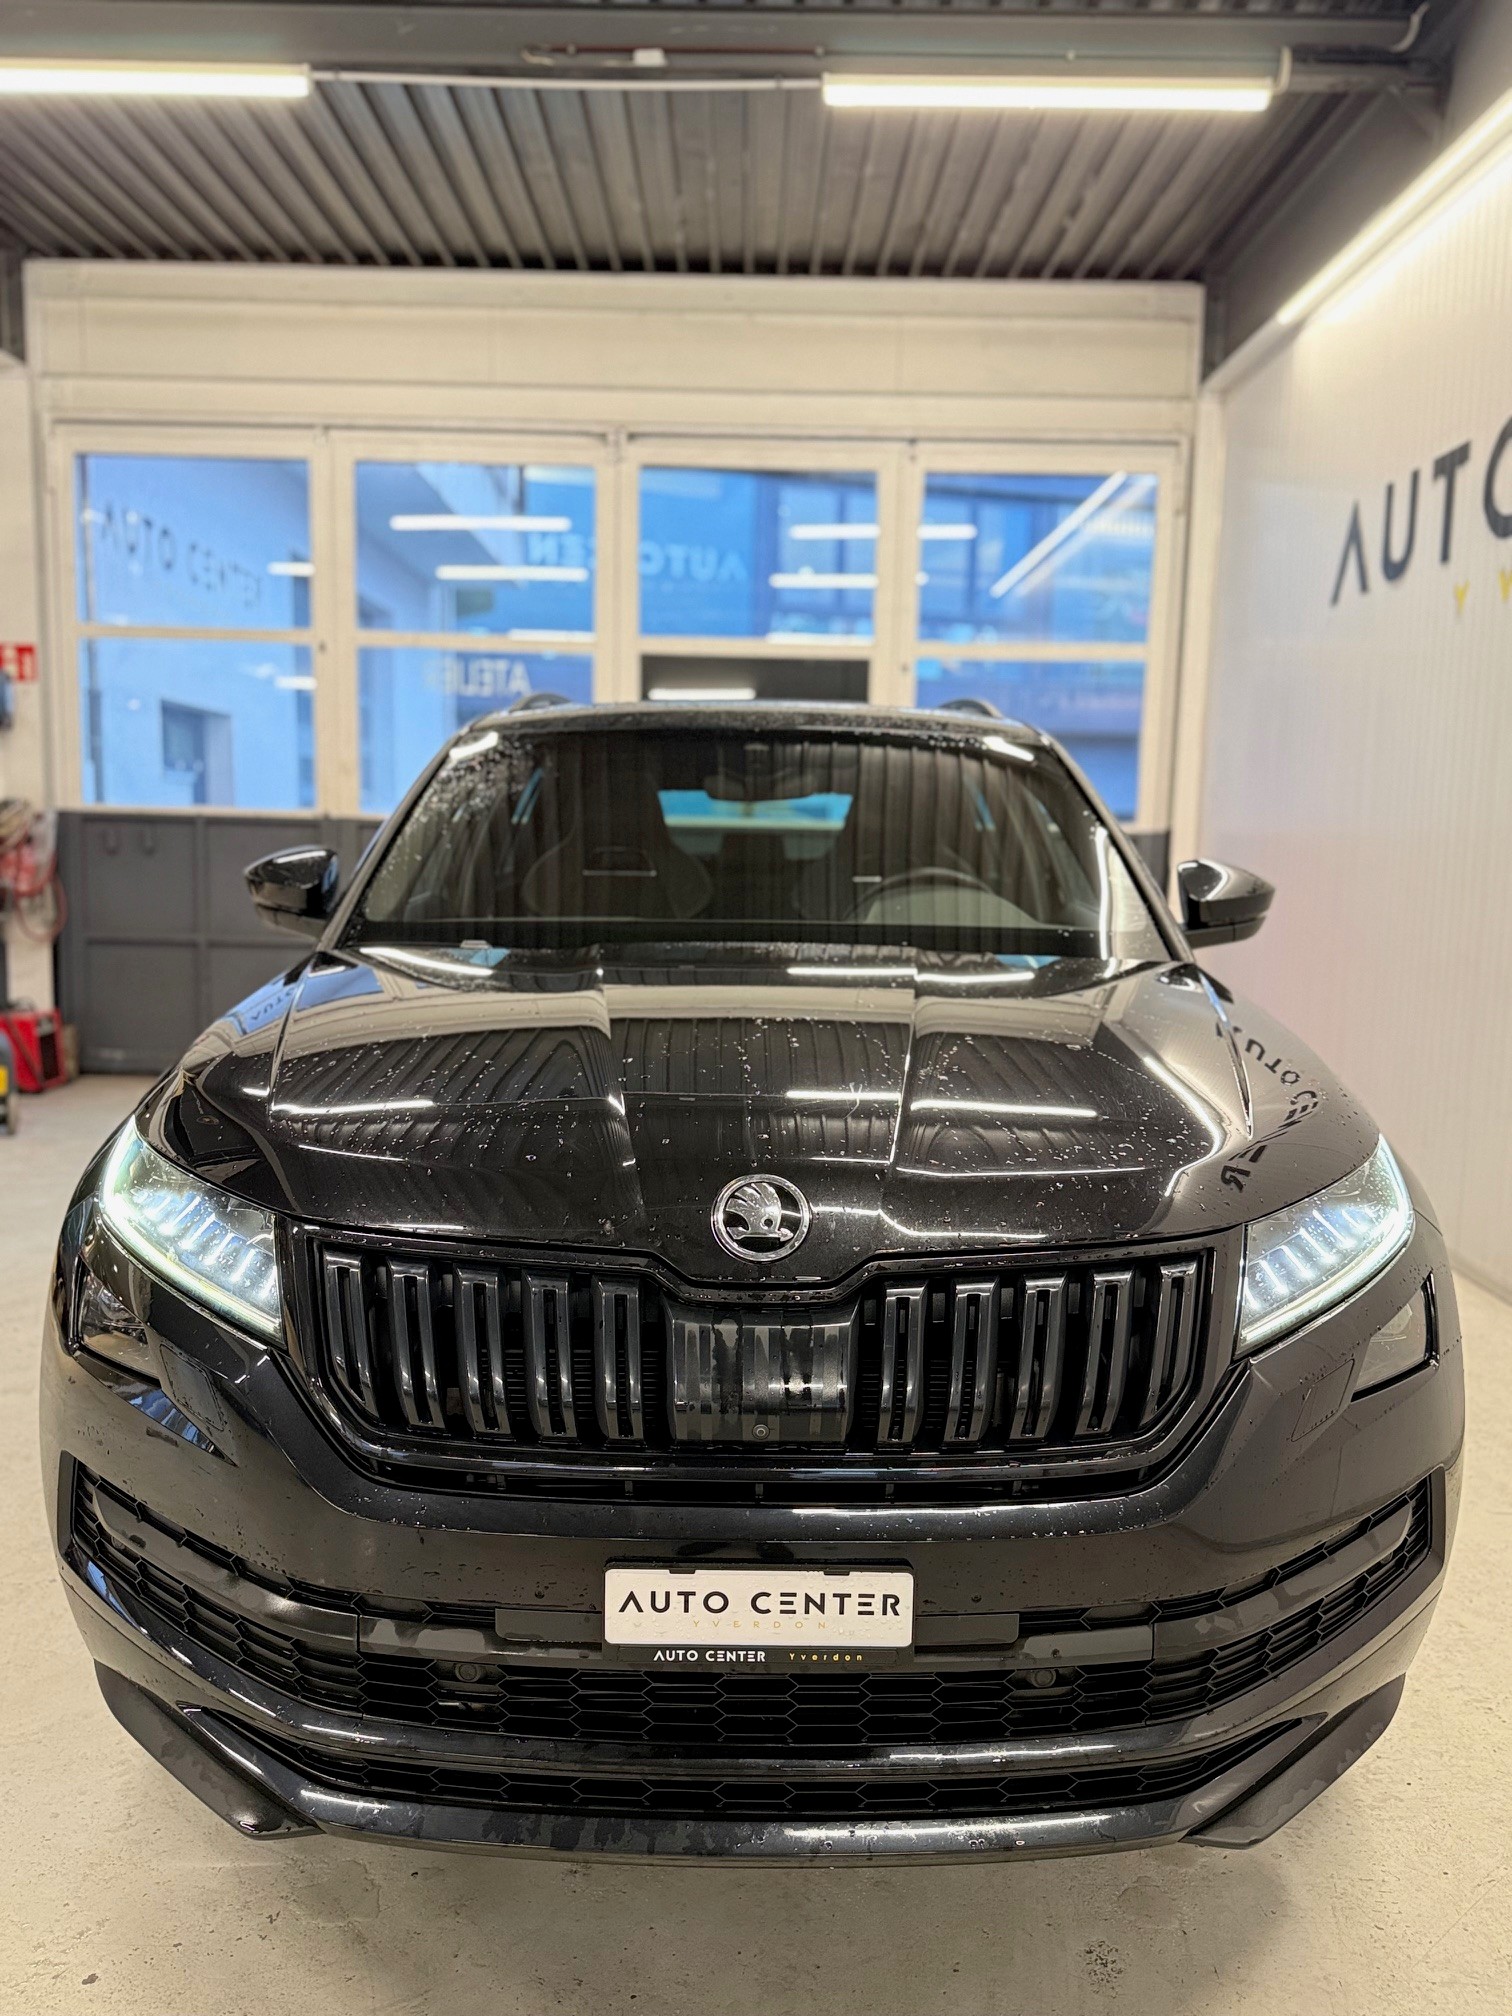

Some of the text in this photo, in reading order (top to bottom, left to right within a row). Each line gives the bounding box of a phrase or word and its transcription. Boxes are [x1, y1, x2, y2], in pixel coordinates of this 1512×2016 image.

[618, 1590, 901, 1617] AUTO CENTER
[693, 1620, 826, 1630] YVERDON
[653, 1649, 863, 1663] AUTO CENTER Yverdon
